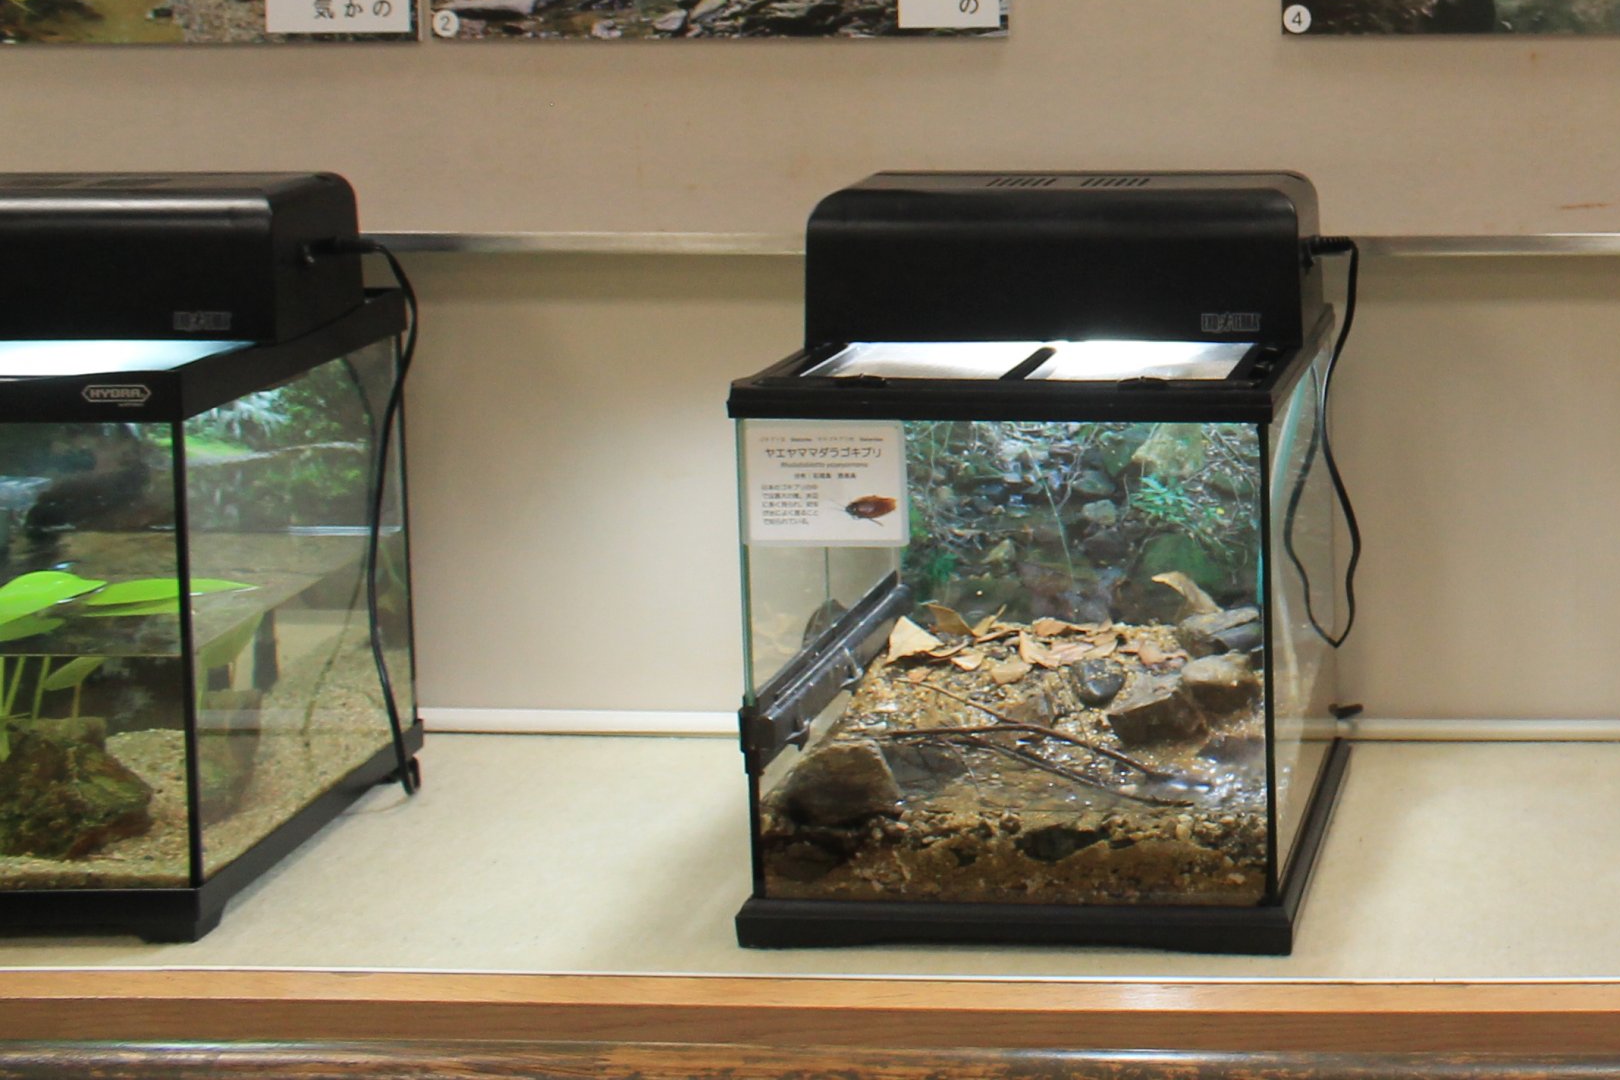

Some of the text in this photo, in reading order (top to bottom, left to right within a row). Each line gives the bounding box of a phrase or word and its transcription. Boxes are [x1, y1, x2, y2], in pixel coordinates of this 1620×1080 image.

[439, 15, 450, 32] 2
[1291, 10, 1303, 27] 4
[764, 445, 882, 459] ヤエヤママダラゴキブリ
